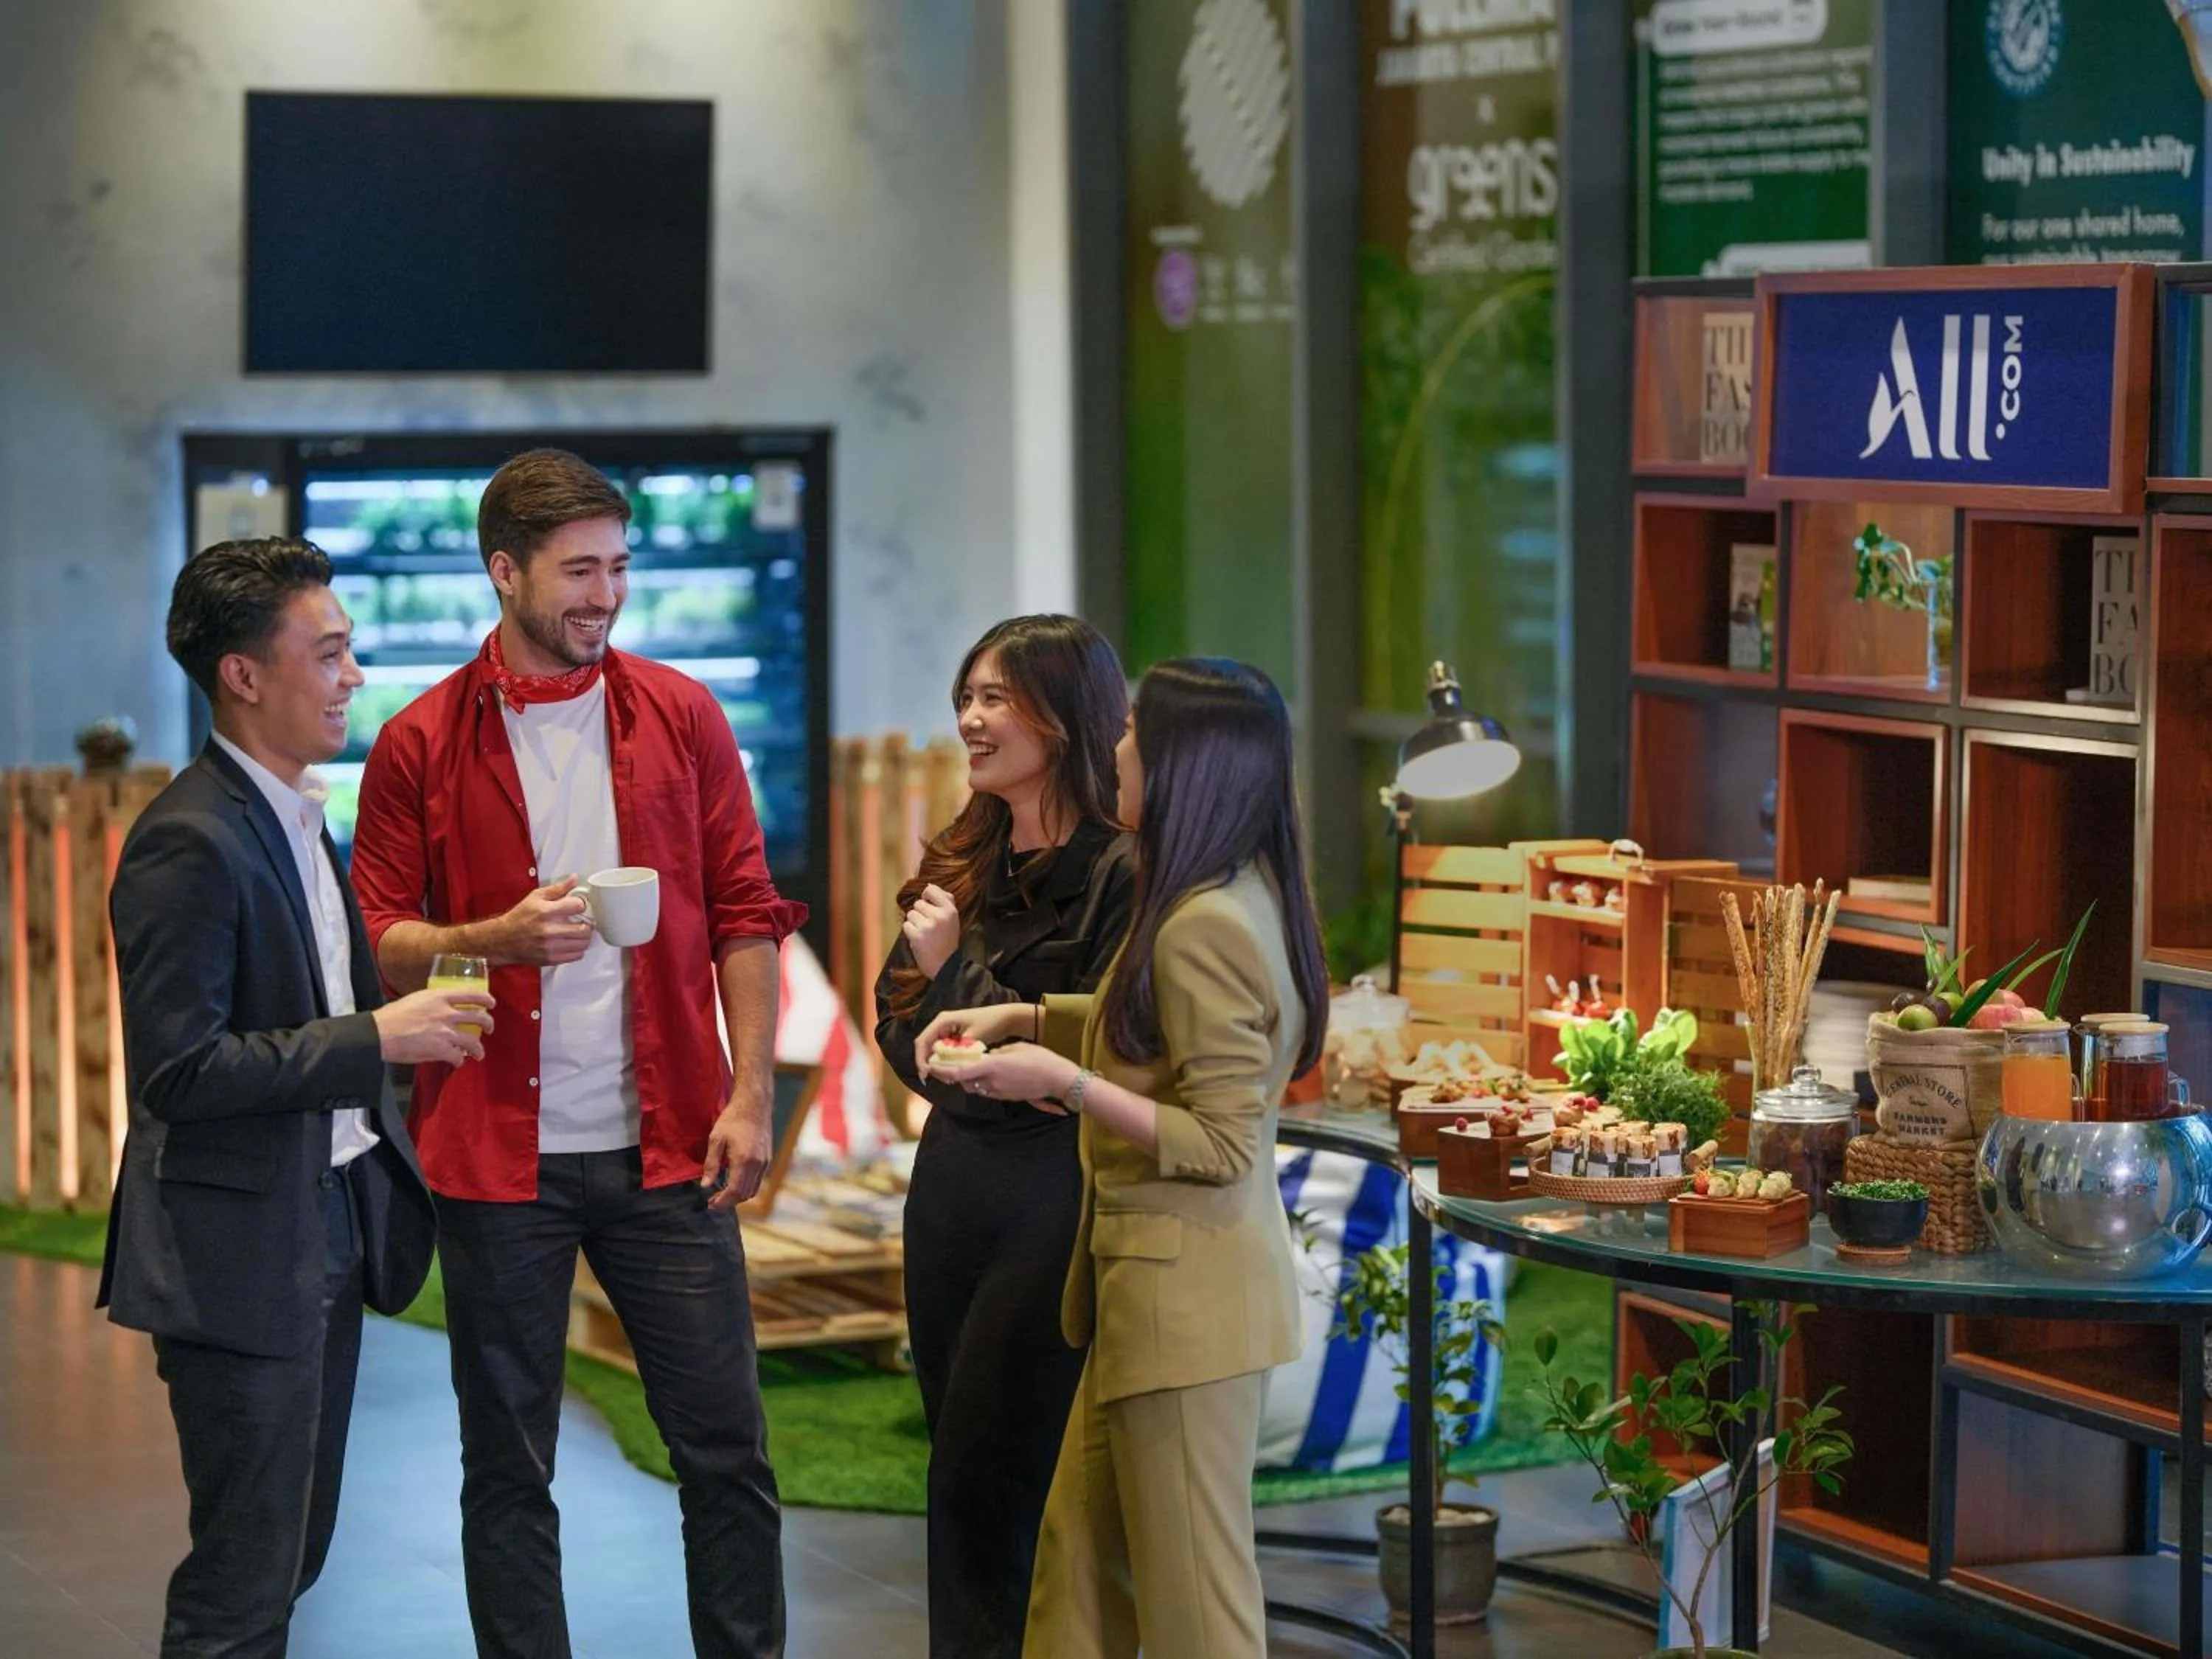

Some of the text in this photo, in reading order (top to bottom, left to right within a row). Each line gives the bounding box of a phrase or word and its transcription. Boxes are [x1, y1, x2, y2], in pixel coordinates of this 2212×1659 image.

[1982, 135, 2195, 187] Unity in Sustainability
[1981, 212, 2009, 242] For
[2011, 220, 2038, 242] our
[2041, 218, 2073, 240] one
[2075, 207, 2129, 238] shared
[1924, 1077, 1963, 1108] STORE
[1893, 1112, 1947, 1124] FARMERS
[1898, 1124, 1945, 1136] MARKET
